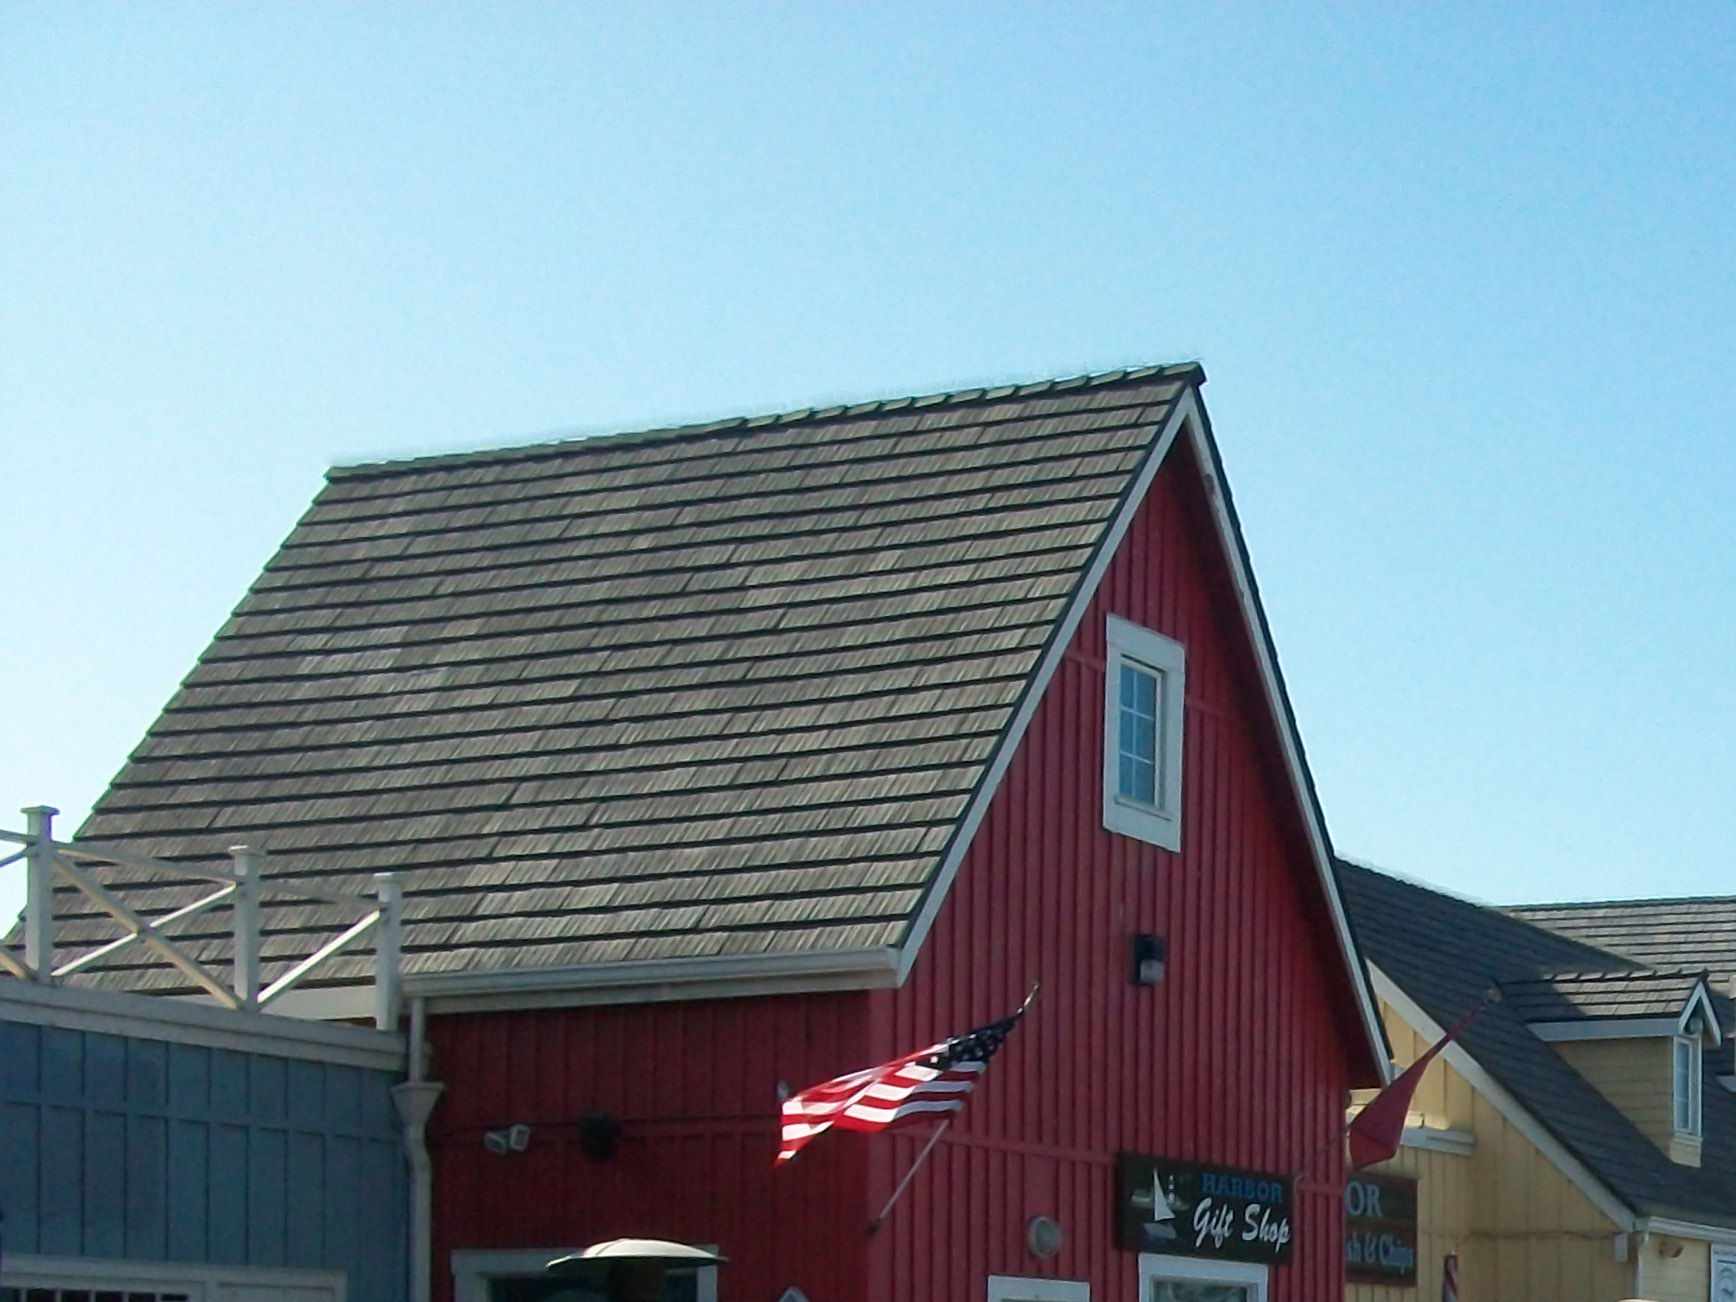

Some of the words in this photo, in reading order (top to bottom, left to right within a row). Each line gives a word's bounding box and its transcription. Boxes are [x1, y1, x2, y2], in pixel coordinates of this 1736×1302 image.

[1202, 1172, 1282, 1203] HARBOR
[1193, 1197, 1234, 1249] Gift
[1242, 1203, 1290, 1254] Shop
